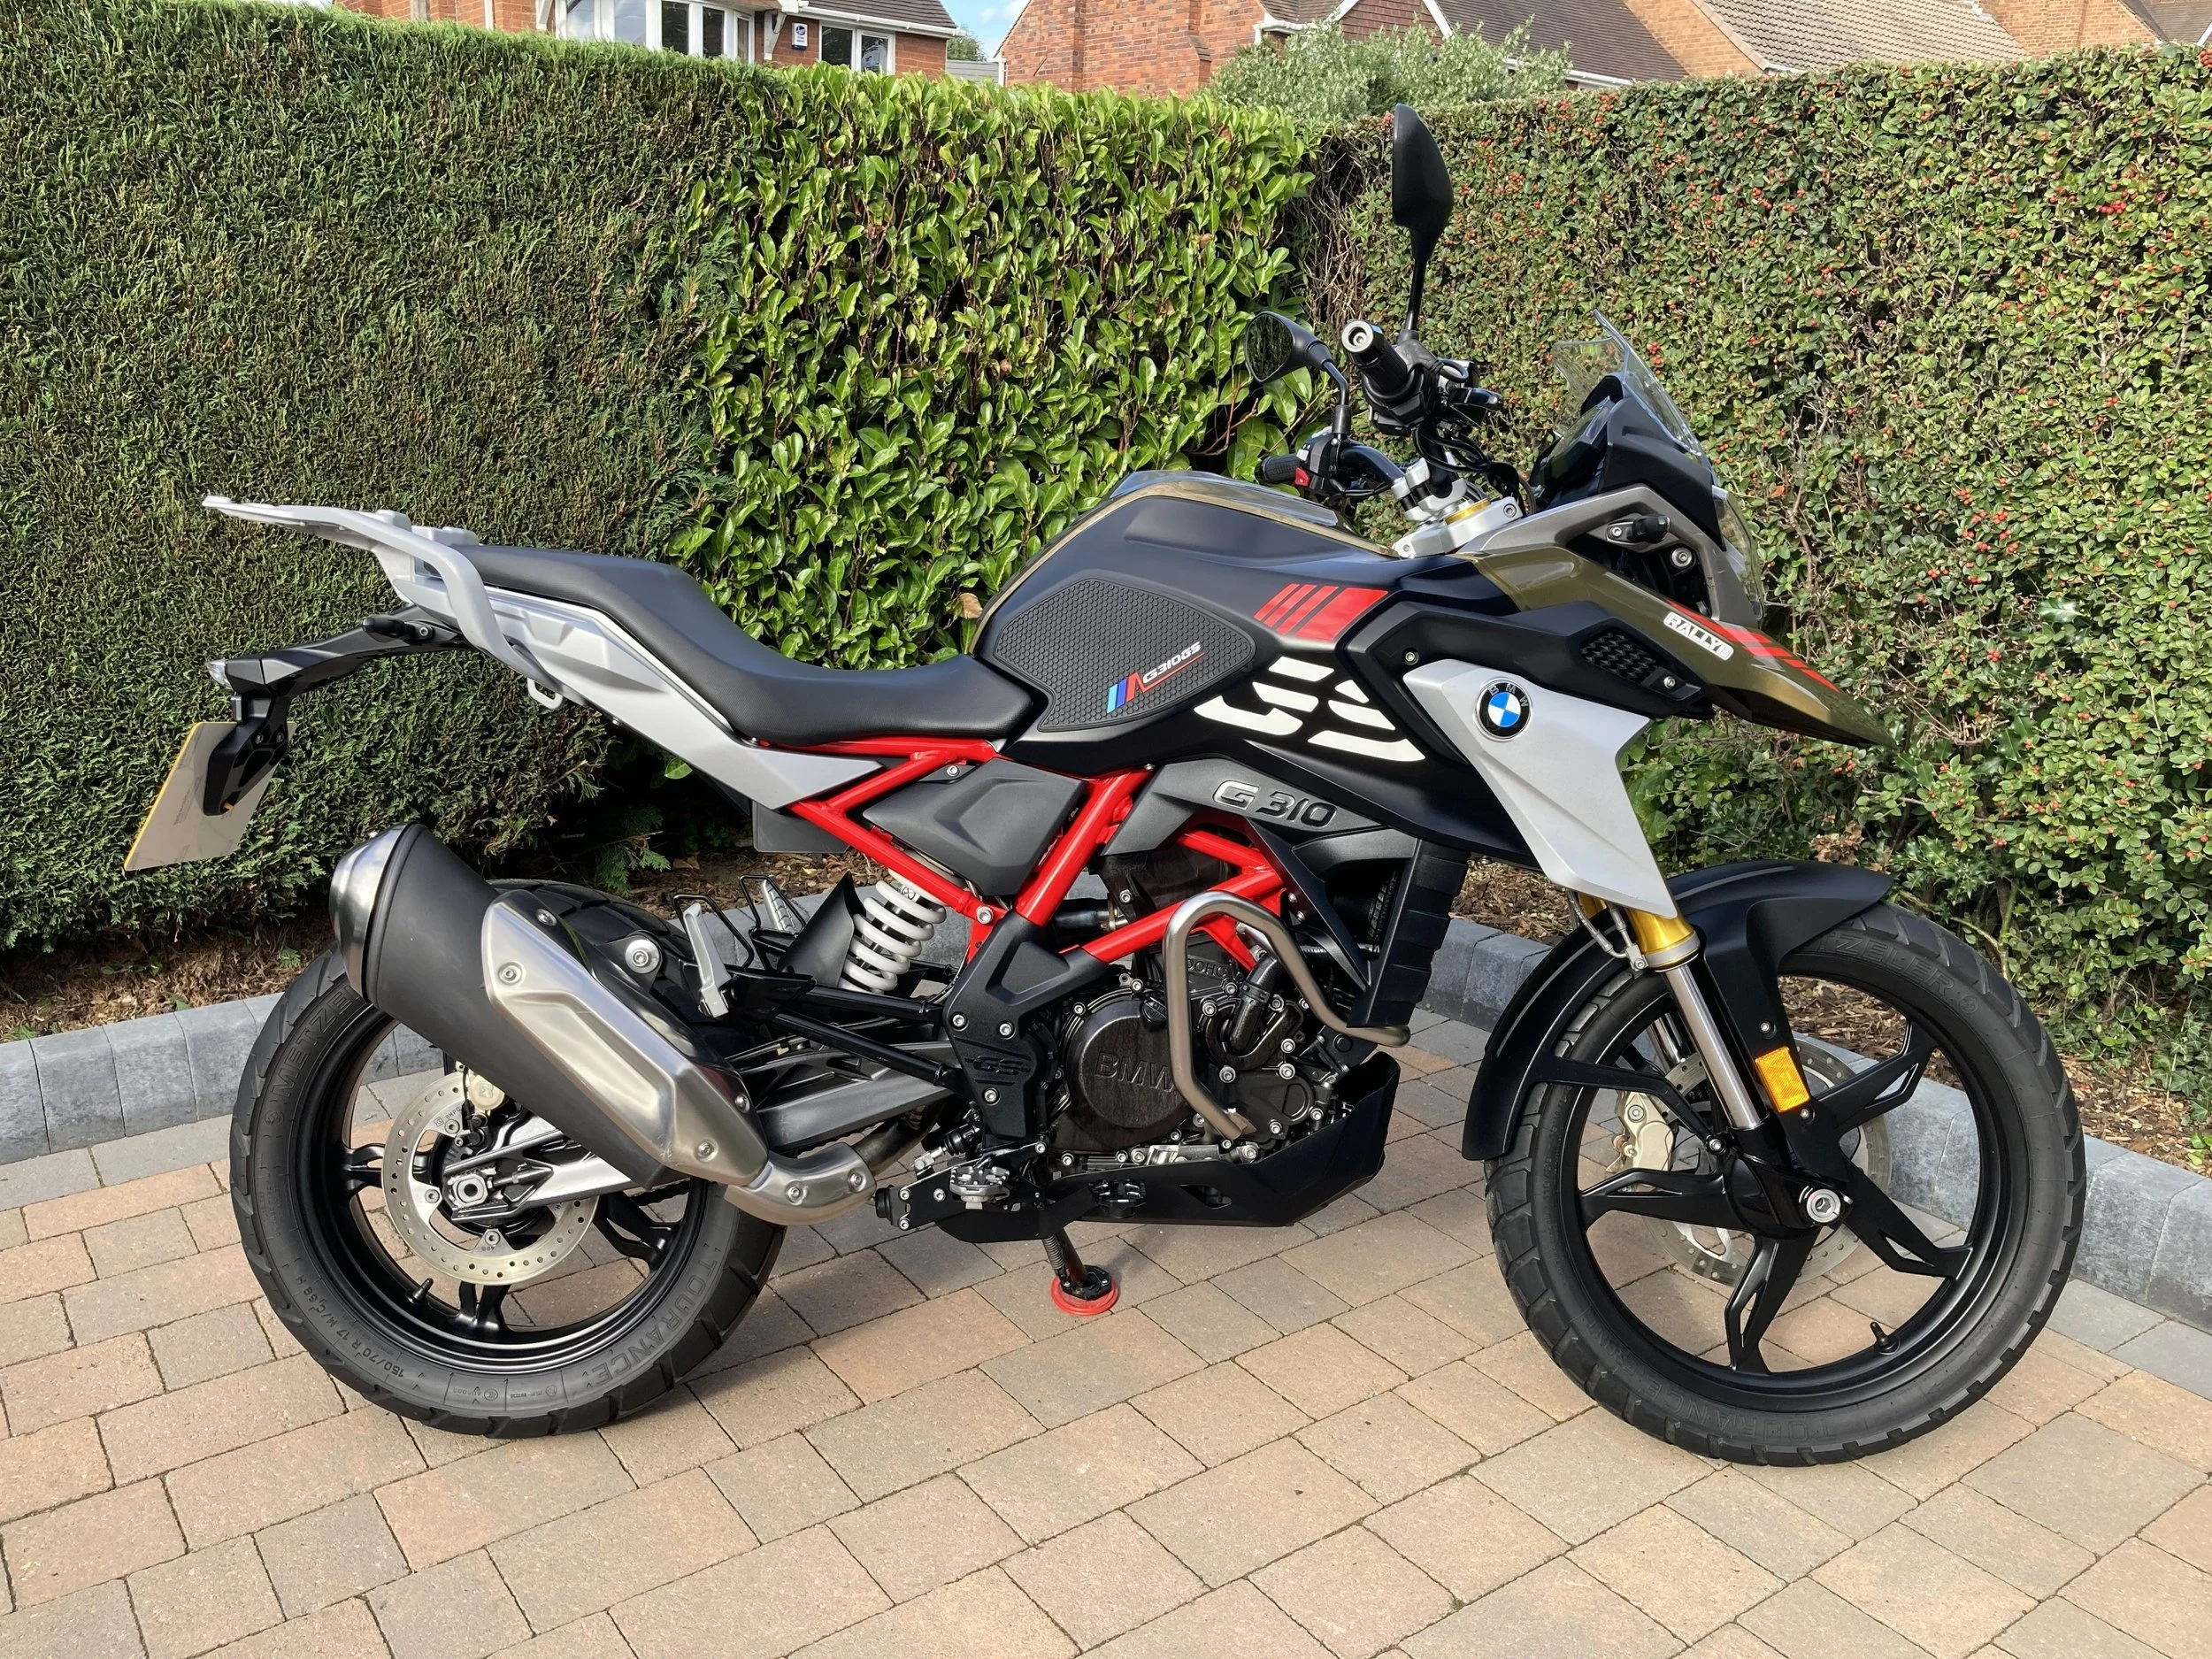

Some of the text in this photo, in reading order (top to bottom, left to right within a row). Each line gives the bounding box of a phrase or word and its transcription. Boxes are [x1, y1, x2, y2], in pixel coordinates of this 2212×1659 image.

[1142, 641, 1202, 684] G310GS
[1487, 682, 1530, 707] BMW
[1212, 780, 1338, 827] G 310
[1094, 1050, 1175, 1093] BMW
[335, 1328, 350, 1340] 17
[593, 1259, 718, 1385] TOURANCE
[351, 1338, 362, 1349] R
[361, 1347, 404, 1379] 150/70
